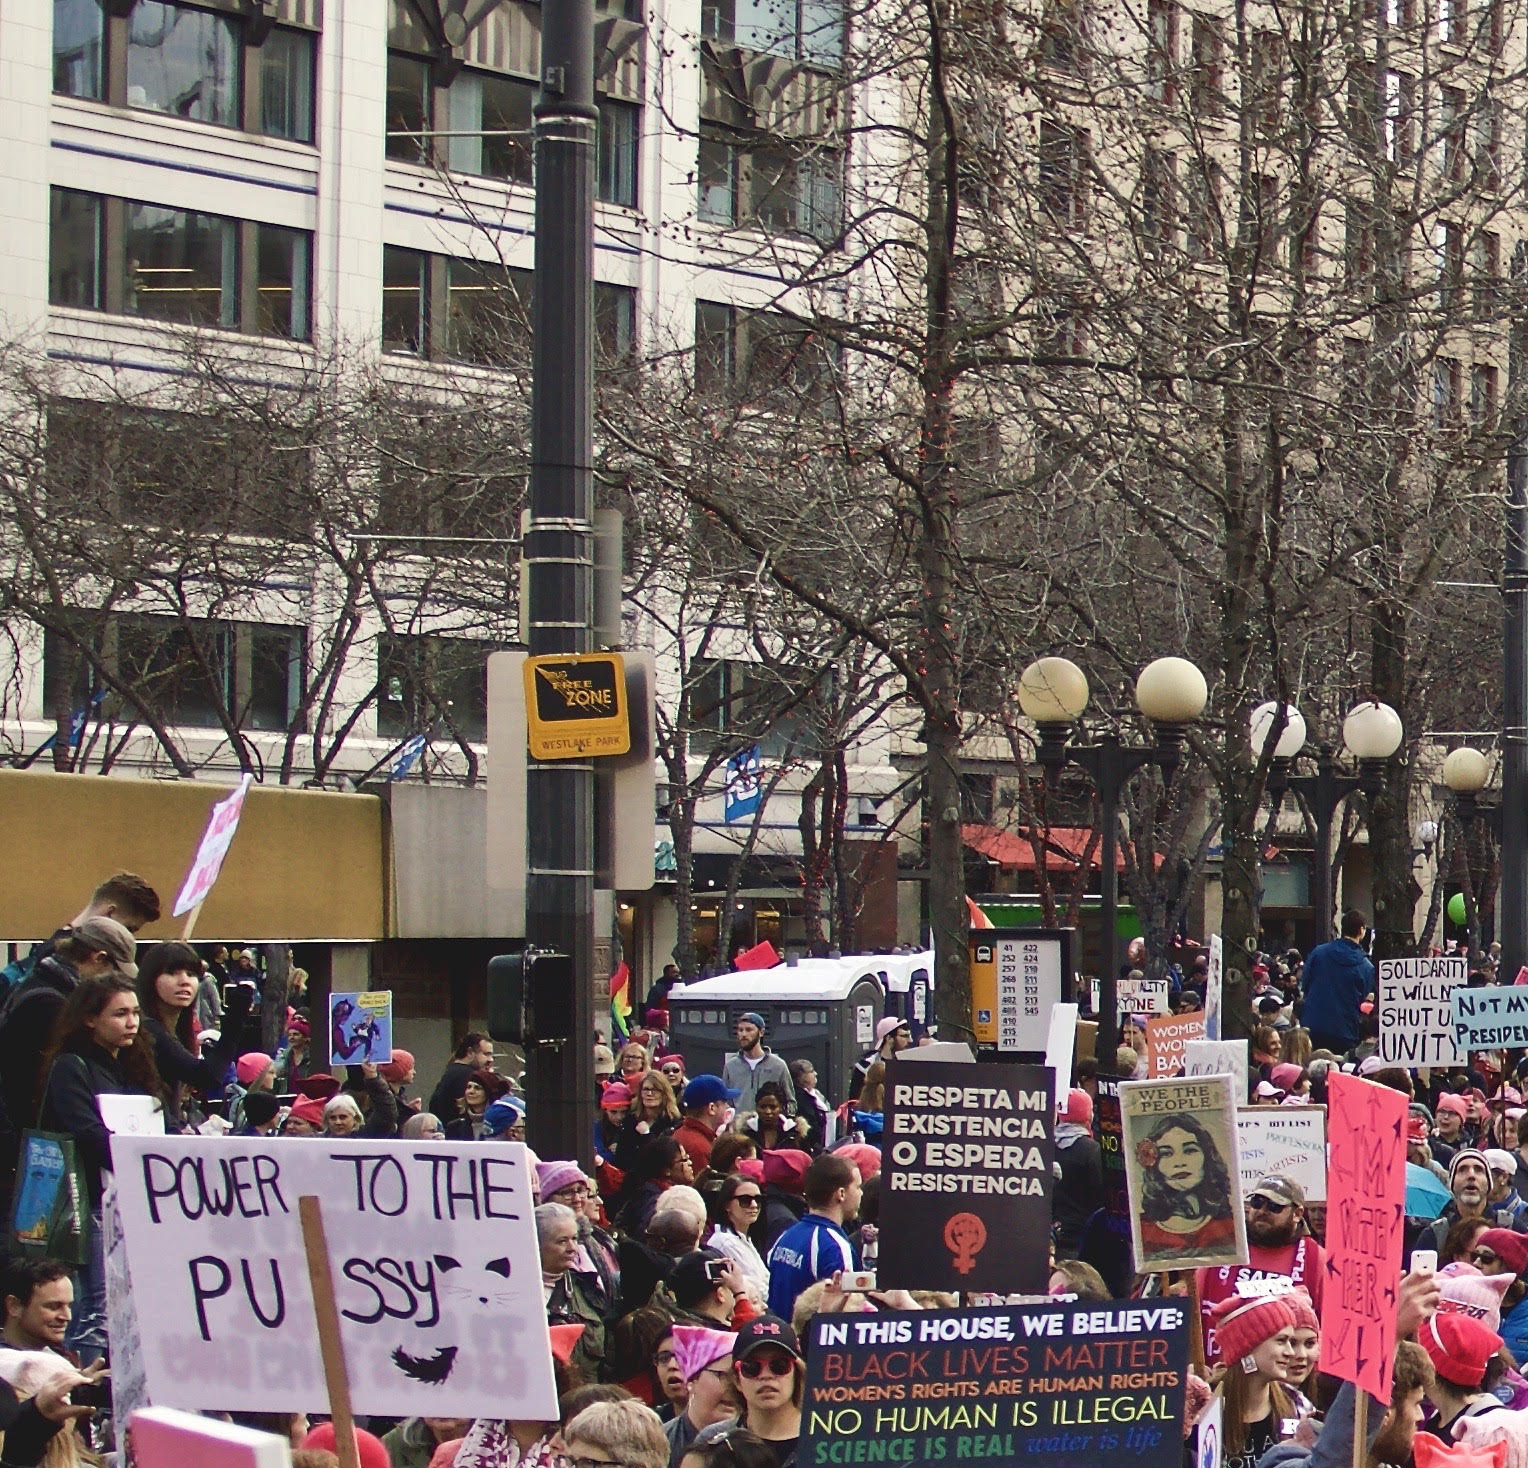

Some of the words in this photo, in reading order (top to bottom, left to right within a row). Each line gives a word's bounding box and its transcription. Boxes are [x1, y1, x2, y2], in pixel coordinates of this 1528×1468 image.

[566, 689, 612, 708] ZONE
[542, 738, 592, 750] WESTLAKE
[596, 736, 621, 746] PARK
[1381, 960, 1468, 980] SOLIDARITY
[1382, 1008, 1433, 1027] SHUT
[894, 1084, 1013, 1111] RESPETA
[1018, 1090, 1047, 1112] MI
[1138, 1090, 1168, 1101] WE
[1173, 1086, 1210, 1098] THE
[1141, 1098, 1211, 1113] PEOPLE
[893, 1113, 1047, 1140] EXISTENCIA
[892, 1141, 918, 1166] O
[925, 1142, 1046, 1171] ESPERA
[142, 1154, 290, 1225] POWER
[330, 1154, 408, 1216] TO
[414, 1153, 519, 1221] THE
[891, 1172, 1044, 1197] RESISTENCIA
[1339, 1197, 1387, 1261] WITH
[1341, 1258, 1383, 1323] HER
[819, 1323, 837, 1346] IN
[855, 1320, 915, 1345] THIS
[920, 1315, 1015, 1343] HOUSE,
[1023, 1313, 1064, 1337] WE
[1072, 1308, 1185, 1335] BELIEVE:
[823, 1350, 931, 1383] BLACK
[943, 1345, 1029, 1379] LIVES
[1043, 1339, 1169, 1372] MATTER
[812, 1383, 905, 1404] WOMEN'S
[911, 1381, 980, 1399] RIGHTS
[985, 1379, 1022, 1396] ARE
[1028, 1375, 1103, 1395] HUMAN
[1109, 1371, 1180, 1390] RIGHTS
[808, 1408, 862, 1436] NO
[875, 1403, 998, 1434] HUMAN
[1012, 1400, 1039, 1427] IS
[1052, 1394, 1175, 1425] ILLEGAL
[814, 1437, 914, 1465] SCIENCE
[924, 1437, 947, 1461] IS
[956, 1434, 1016, 1459] REAL
[1124, 1427, 1163, 1453] life
